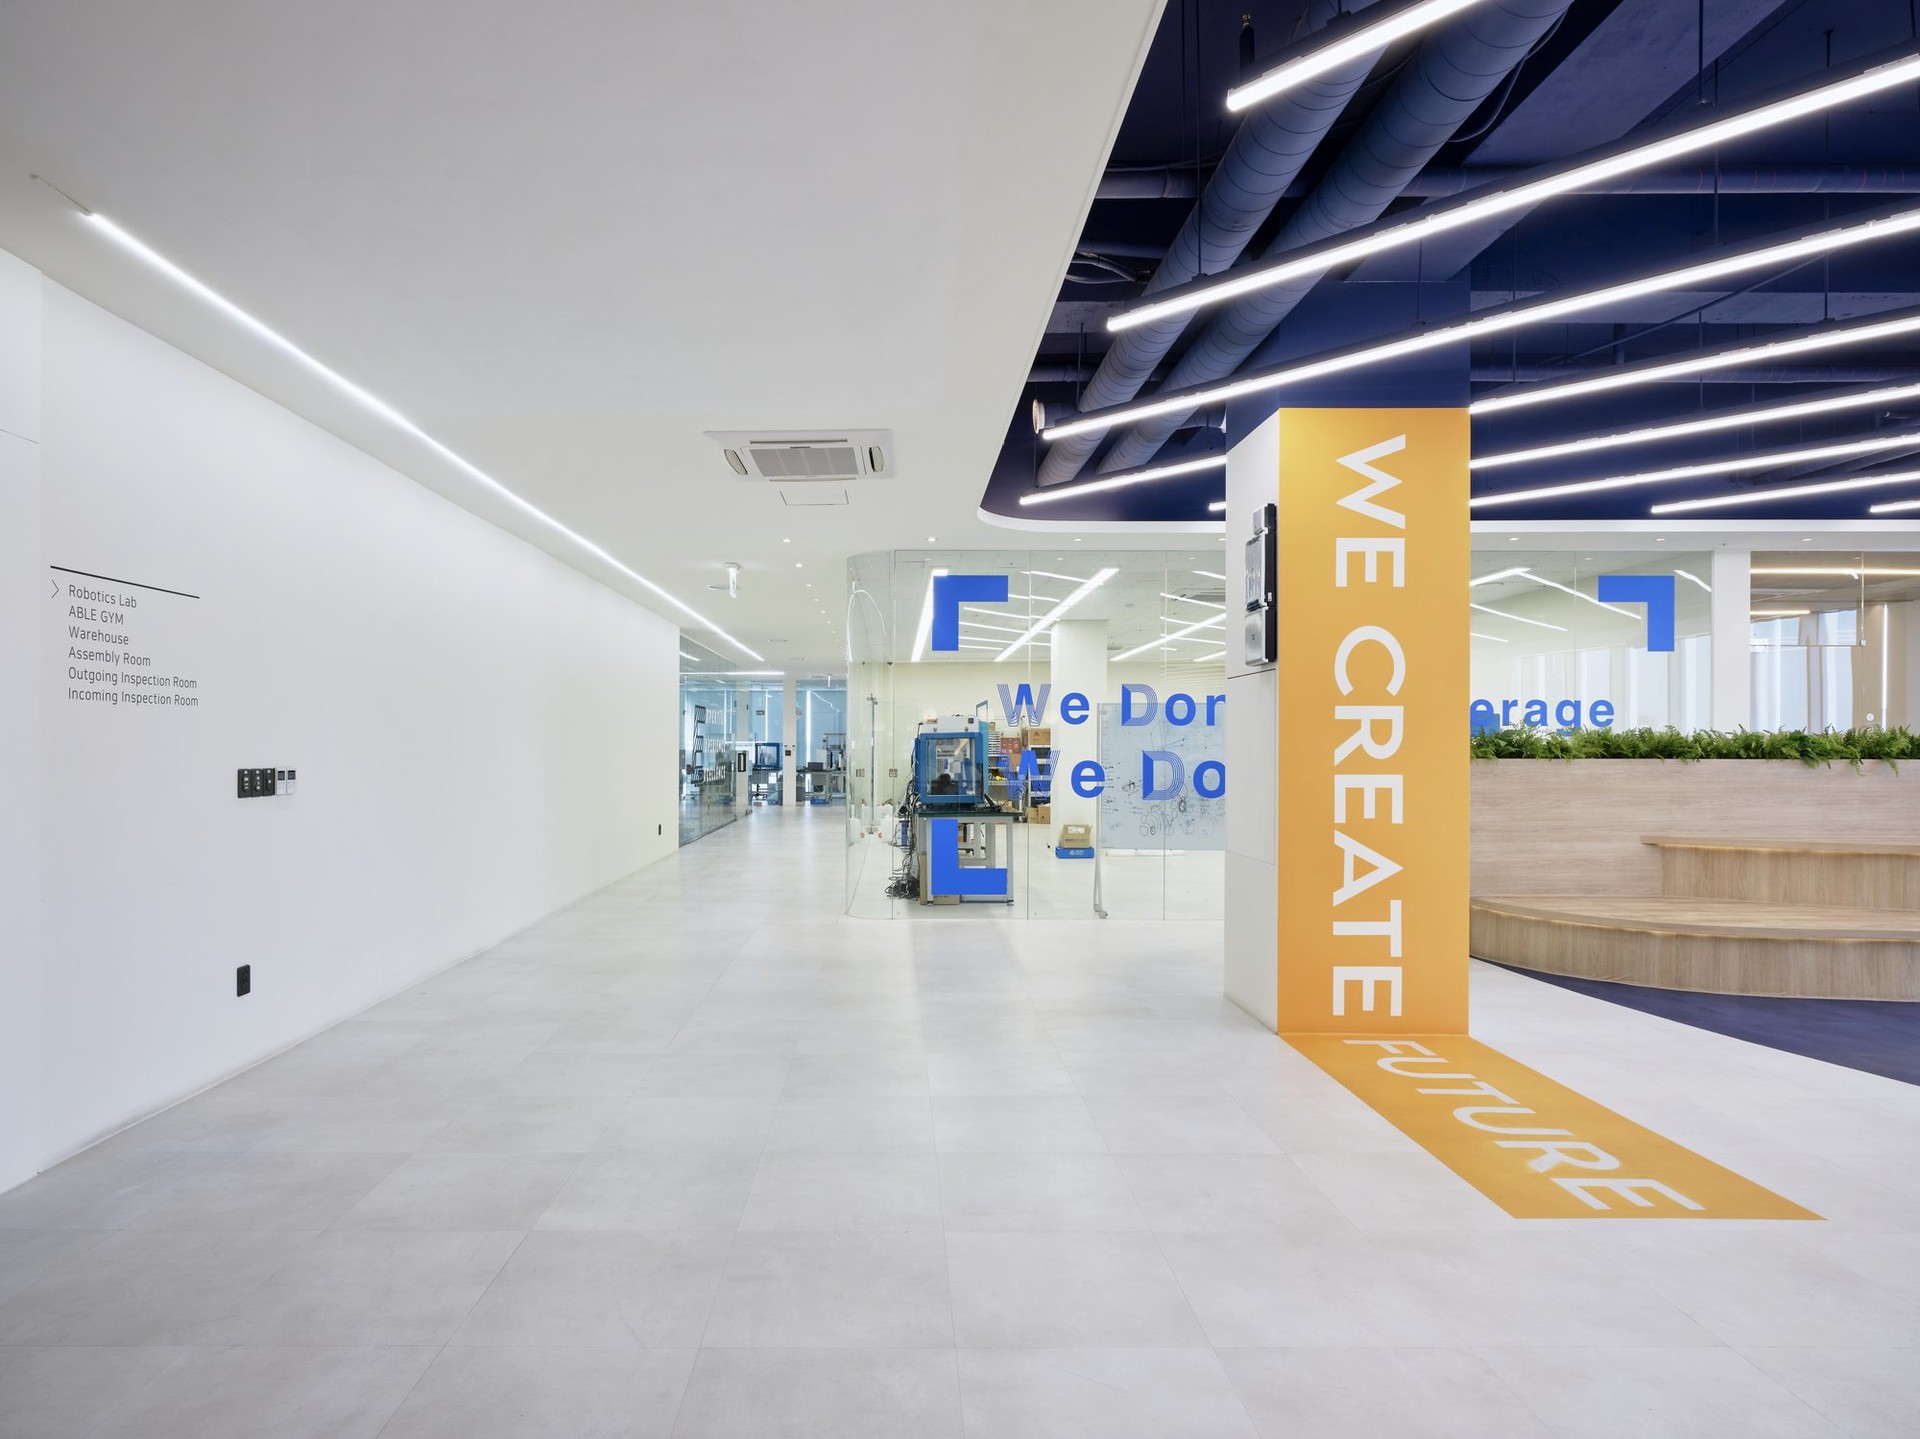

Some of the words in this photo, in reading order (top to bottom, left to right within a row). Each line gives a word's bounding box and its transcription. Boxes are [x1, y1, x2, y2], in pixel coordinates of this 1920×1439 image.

[1334, 433, 1407, 589] WE
[68, 584, 115, 604] Robotics
[118, 593, 136, 607] Lab
[68, 605, 96, 621] ABLE
[100, 610, 123, 625] GYM
[68, 625, 128, 644] Warehouse
[68, 646, 120, 666] Assembly
[123, 652, 150, 666] Room
[68, 666, 117, 685] Outgoing
[121, 671, 170, 686] Inspection
[173, 676, 197, 689] Room
[68, 687, 117, 704] Incoming
[121, 691, 171, 705] Inspection
[174, 694, 198, 707] Room
[996, 683, 1090, 727] We
[998, 750, 1106, 801] We
[1331, 624, 1407, 1018] CREATE
[1341, 1038, 1706, 1212] FUTURE
